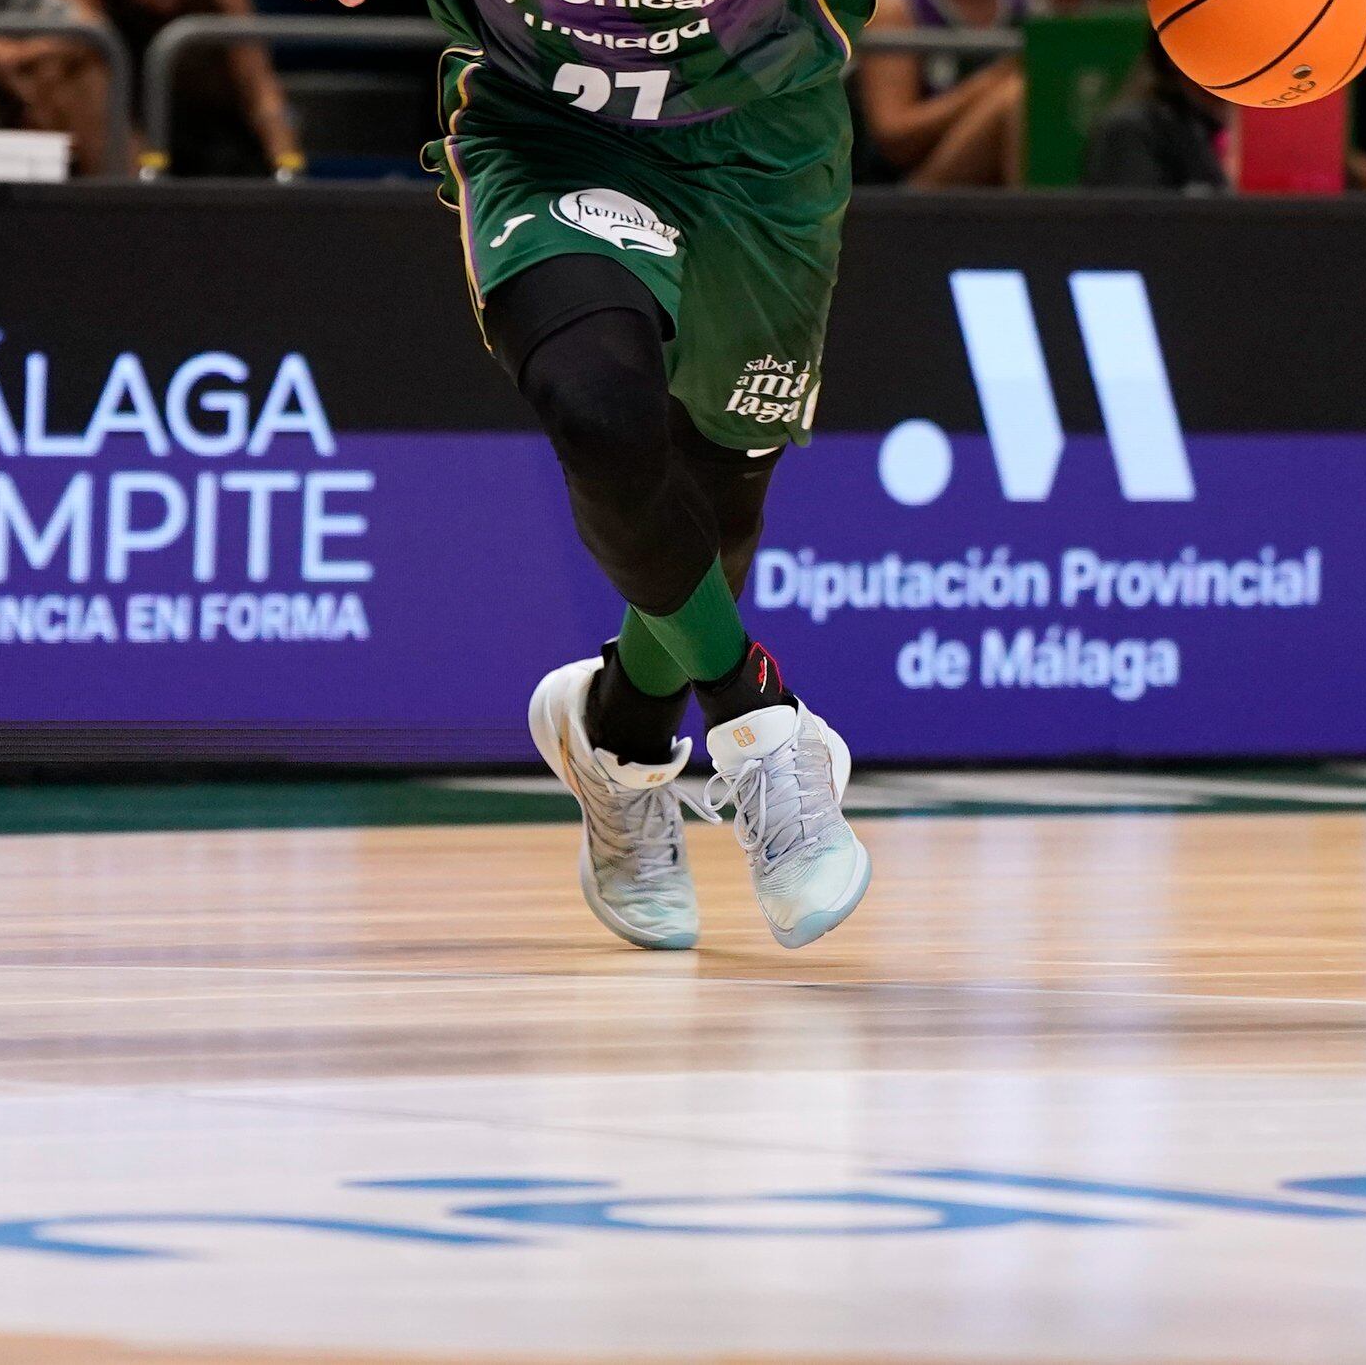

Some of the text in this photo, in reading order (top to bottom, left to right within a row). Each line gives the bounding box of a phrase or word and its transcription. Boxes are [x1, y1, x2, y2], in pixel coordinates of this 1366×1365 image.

[743, 354, 797, 374] sabor
[755, 548, 1321, 622] Diputación Provincial
[125, 594, 193, 640] EN
[199, 592, 369, 640] FORMA
[896, 626, 1179, 701] de Málaga
